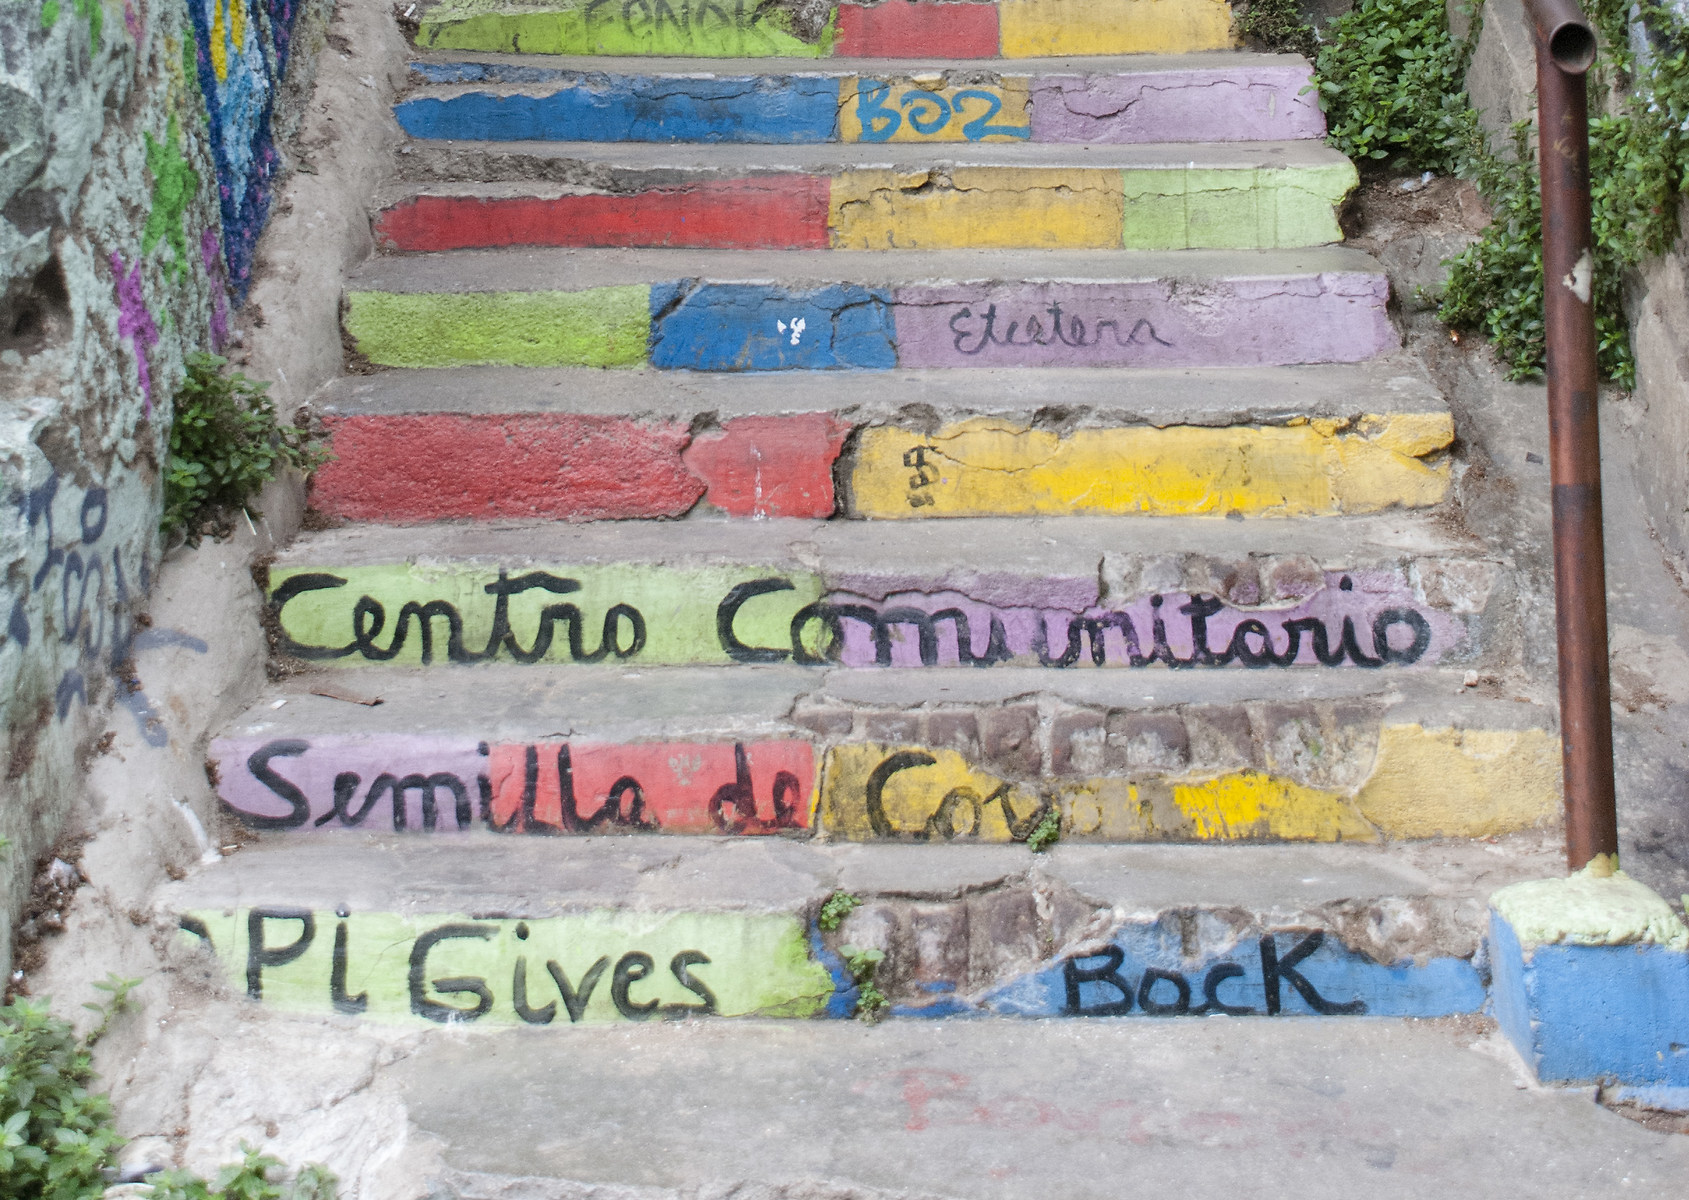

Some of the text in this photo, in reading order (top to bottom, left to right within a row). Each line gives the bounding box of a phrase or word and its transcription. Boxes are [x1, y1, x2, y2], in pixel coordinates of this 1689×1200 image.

[270, 570, 1432, 669] Centro Comunitario
[217, 739, 662, 835] Semilla
[708, 741, 809, 836] de
